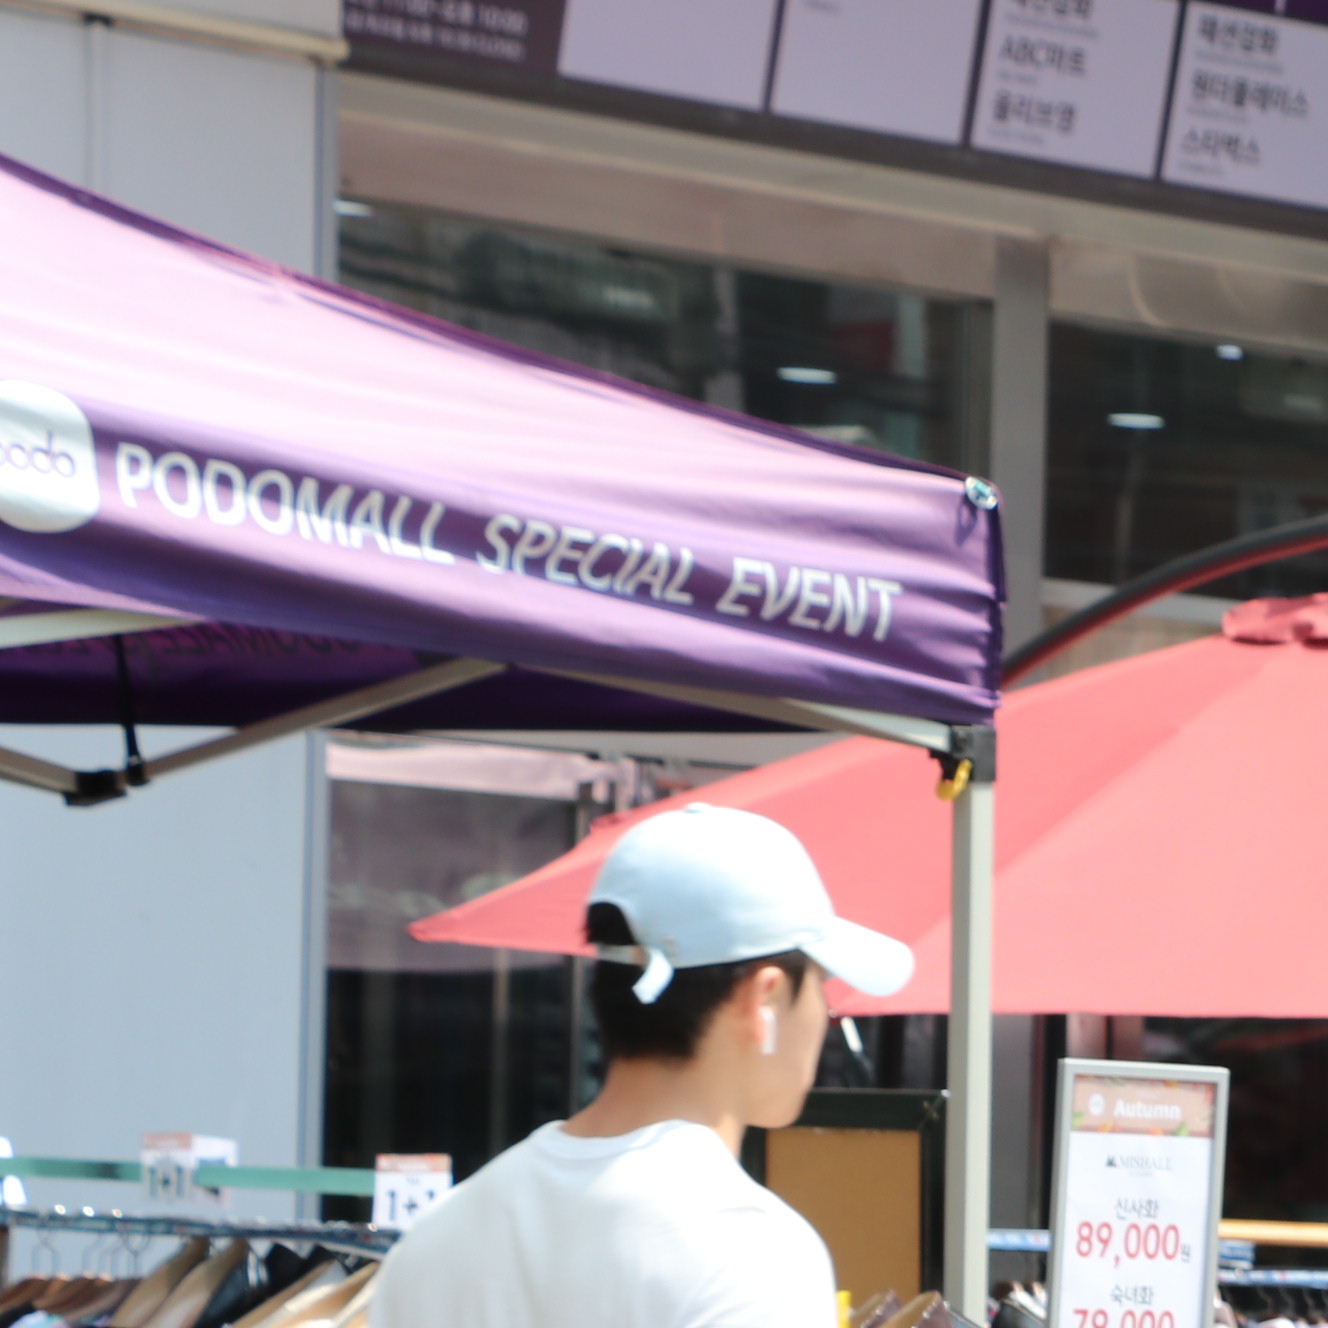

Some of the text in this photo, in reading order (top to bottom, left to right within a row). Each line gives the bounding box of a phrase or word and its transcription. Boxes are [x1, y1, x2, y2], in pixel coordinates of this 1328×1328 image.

[116, 441, 904, 642] PODOMALL SPECIAL EVENT
[1113, 1098, 1183, 1120] Autumn
[1115, 1198, 1159, 1221] 신사화
[1110, 1283, 1155, 1307] 숙녀화
